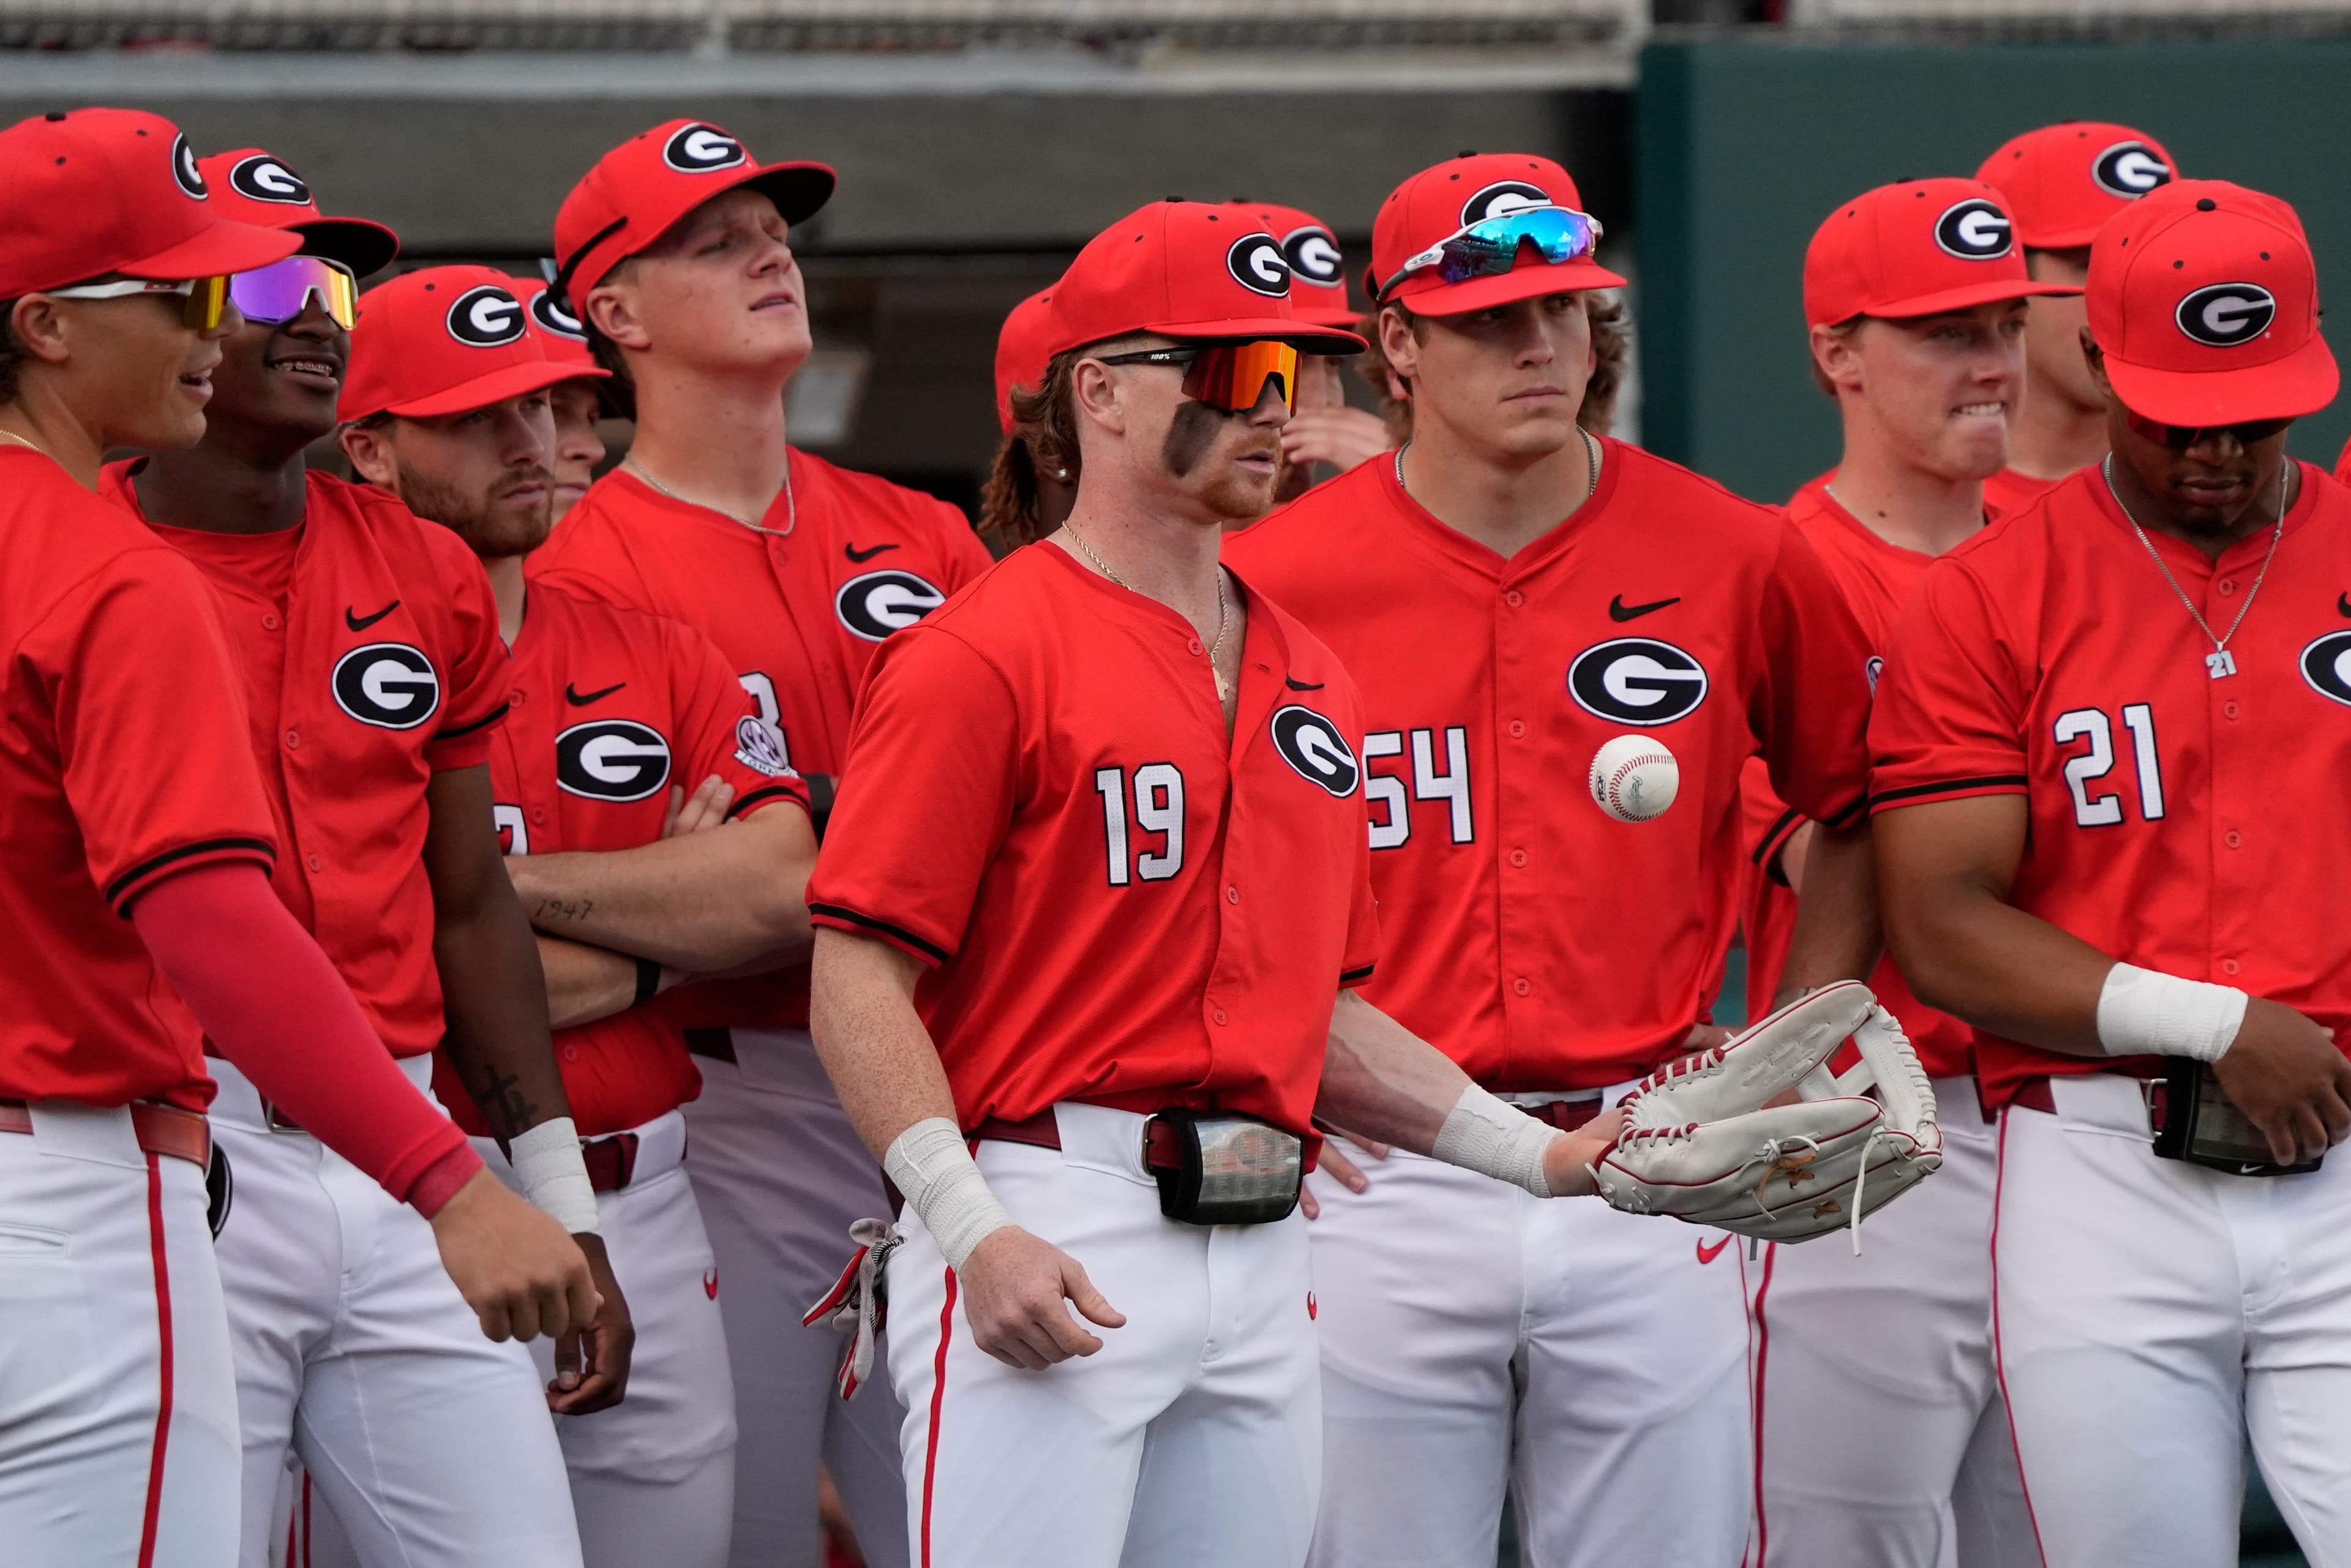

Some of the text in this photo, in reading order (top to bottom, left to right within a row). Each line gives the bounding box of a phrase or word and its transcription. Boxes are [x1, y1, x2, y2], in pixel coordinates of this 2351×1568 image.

[230, 154, 312, 205] G
[662, 122, 746, 173] G
[2091, 141, 2171, 200] G
[1280, 225, 1343, 288] G
[1933, 198, 2012, 260] G
[1226, 232, 1291, 298] G
[447, 285, 526, 347] G
[2175, 282, 2276, 347] G
[835, 569, 947, 643] G
[331, 642, 440, 730] G
[1567, 637, 1709, 726] G
[2206, 650, 2237, 679] 21
[556, 719, 672, 803] G
[1270, 704, 1360, 799] G
[2053, 702, 2165, 828] 21
[1362, 726, 1475, 850] 54
[1095, 760, 1187, 887] 19
[535, 898, 594, 920] 1947
